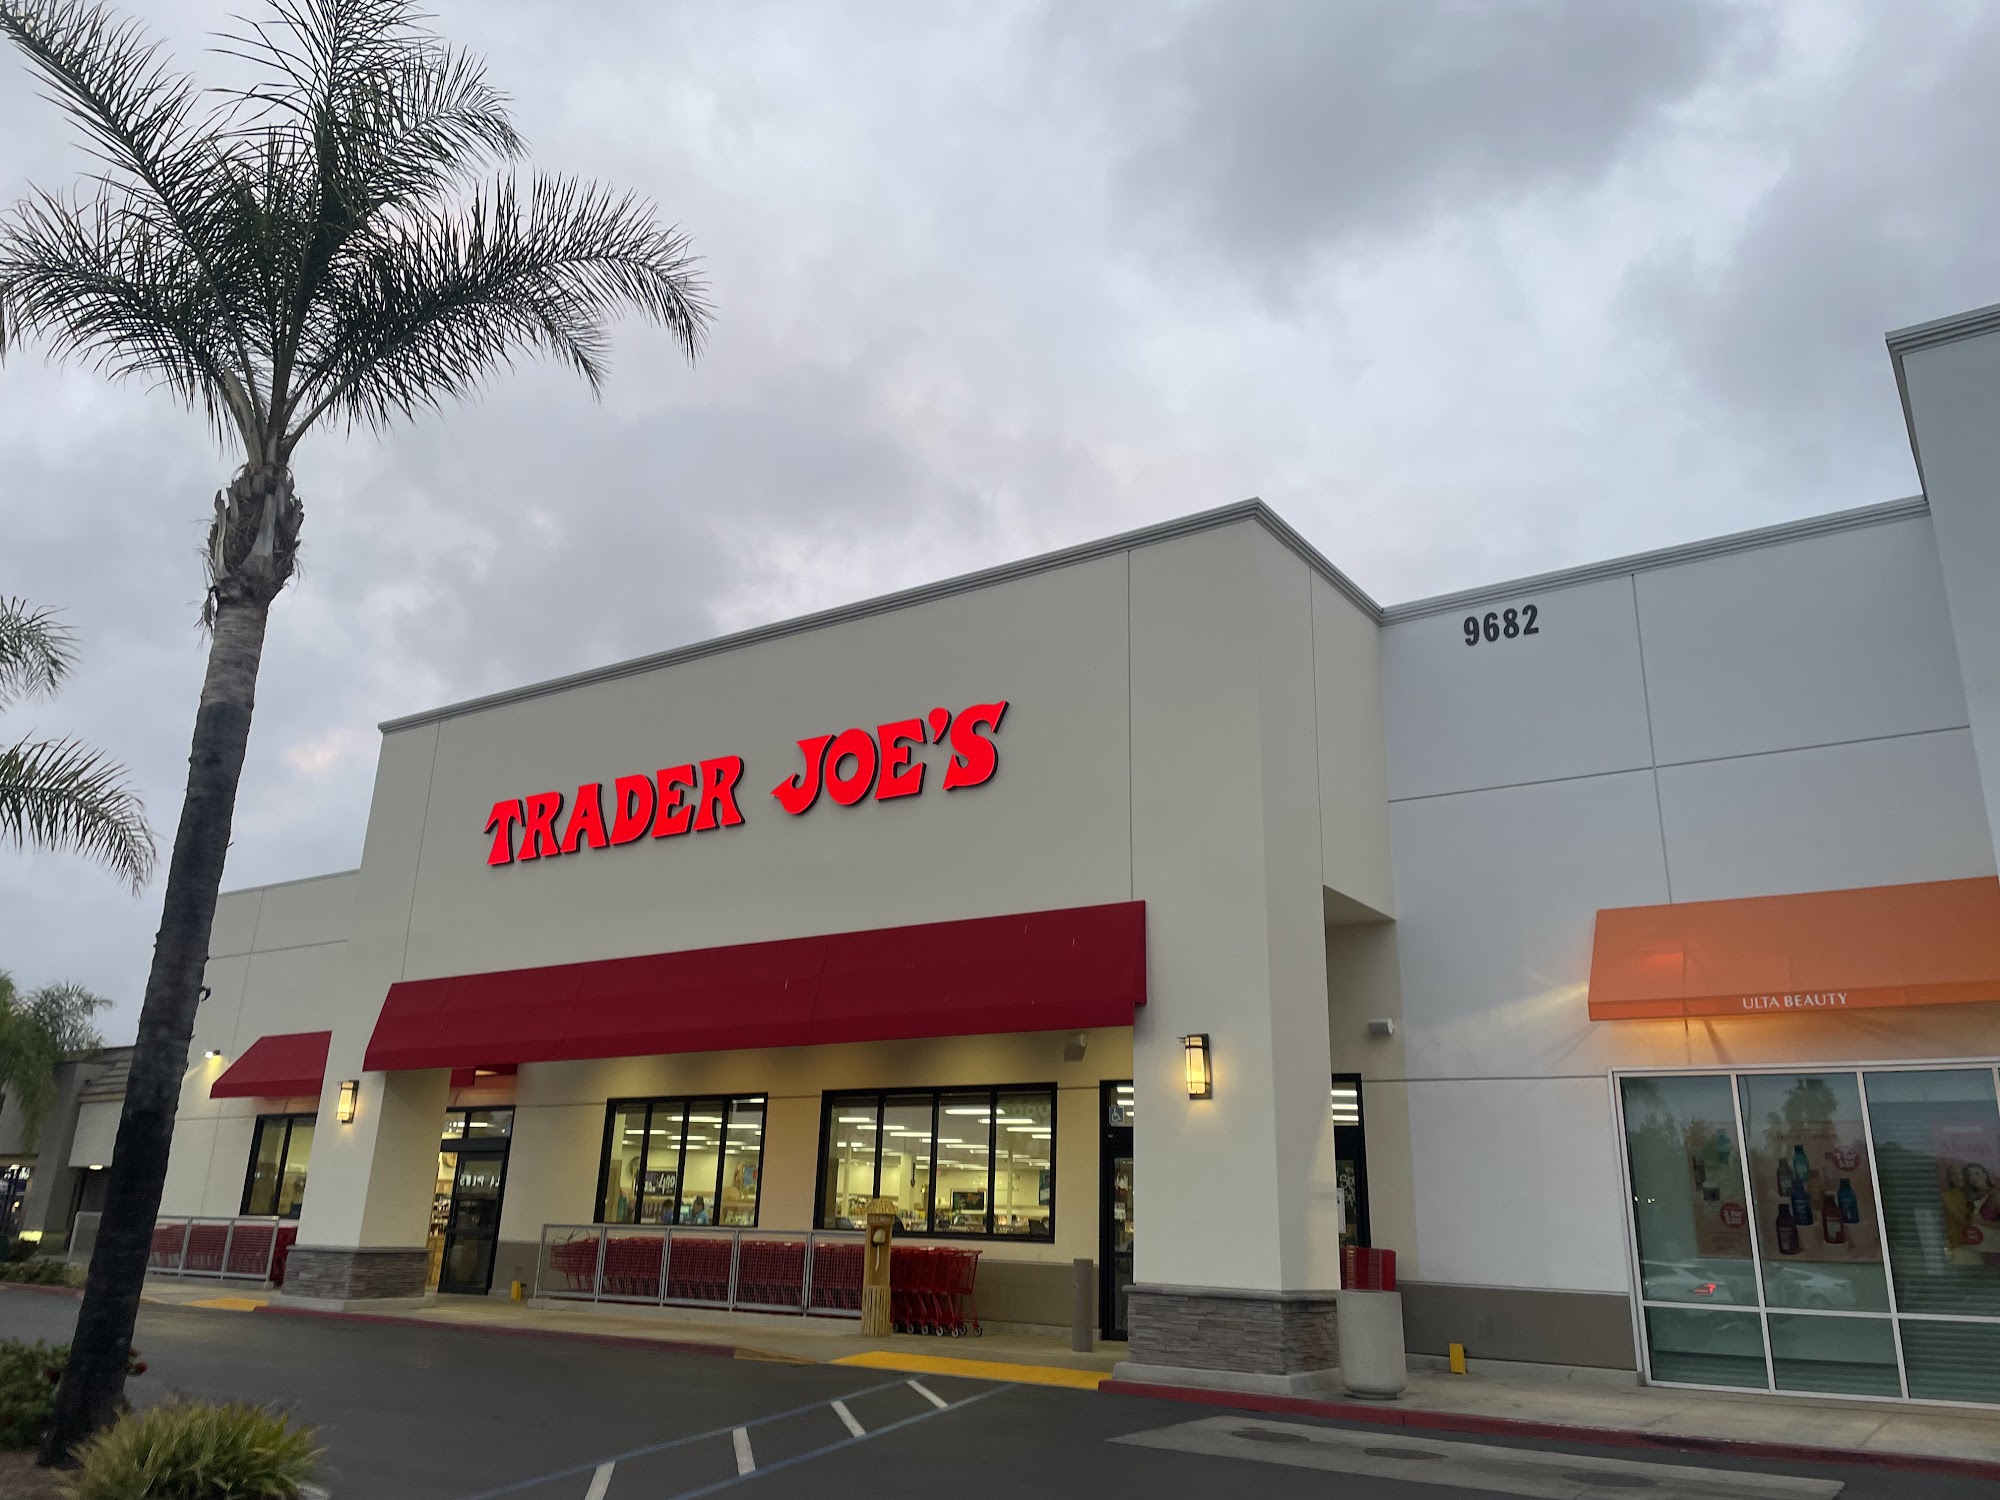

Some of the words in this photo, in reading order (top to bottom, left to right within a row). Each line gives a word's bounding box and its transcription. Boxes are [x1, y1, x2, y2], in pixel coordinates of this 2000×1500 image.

[1463, 604, 1539, 647] 9682
[484, 755, 745, 867] TRADER
[770, 700, 1009, 816] JOE'S
[1742, 996, 1780, 1010] ULTA
[1783, 992, 1848, 1008] BEAUTY
